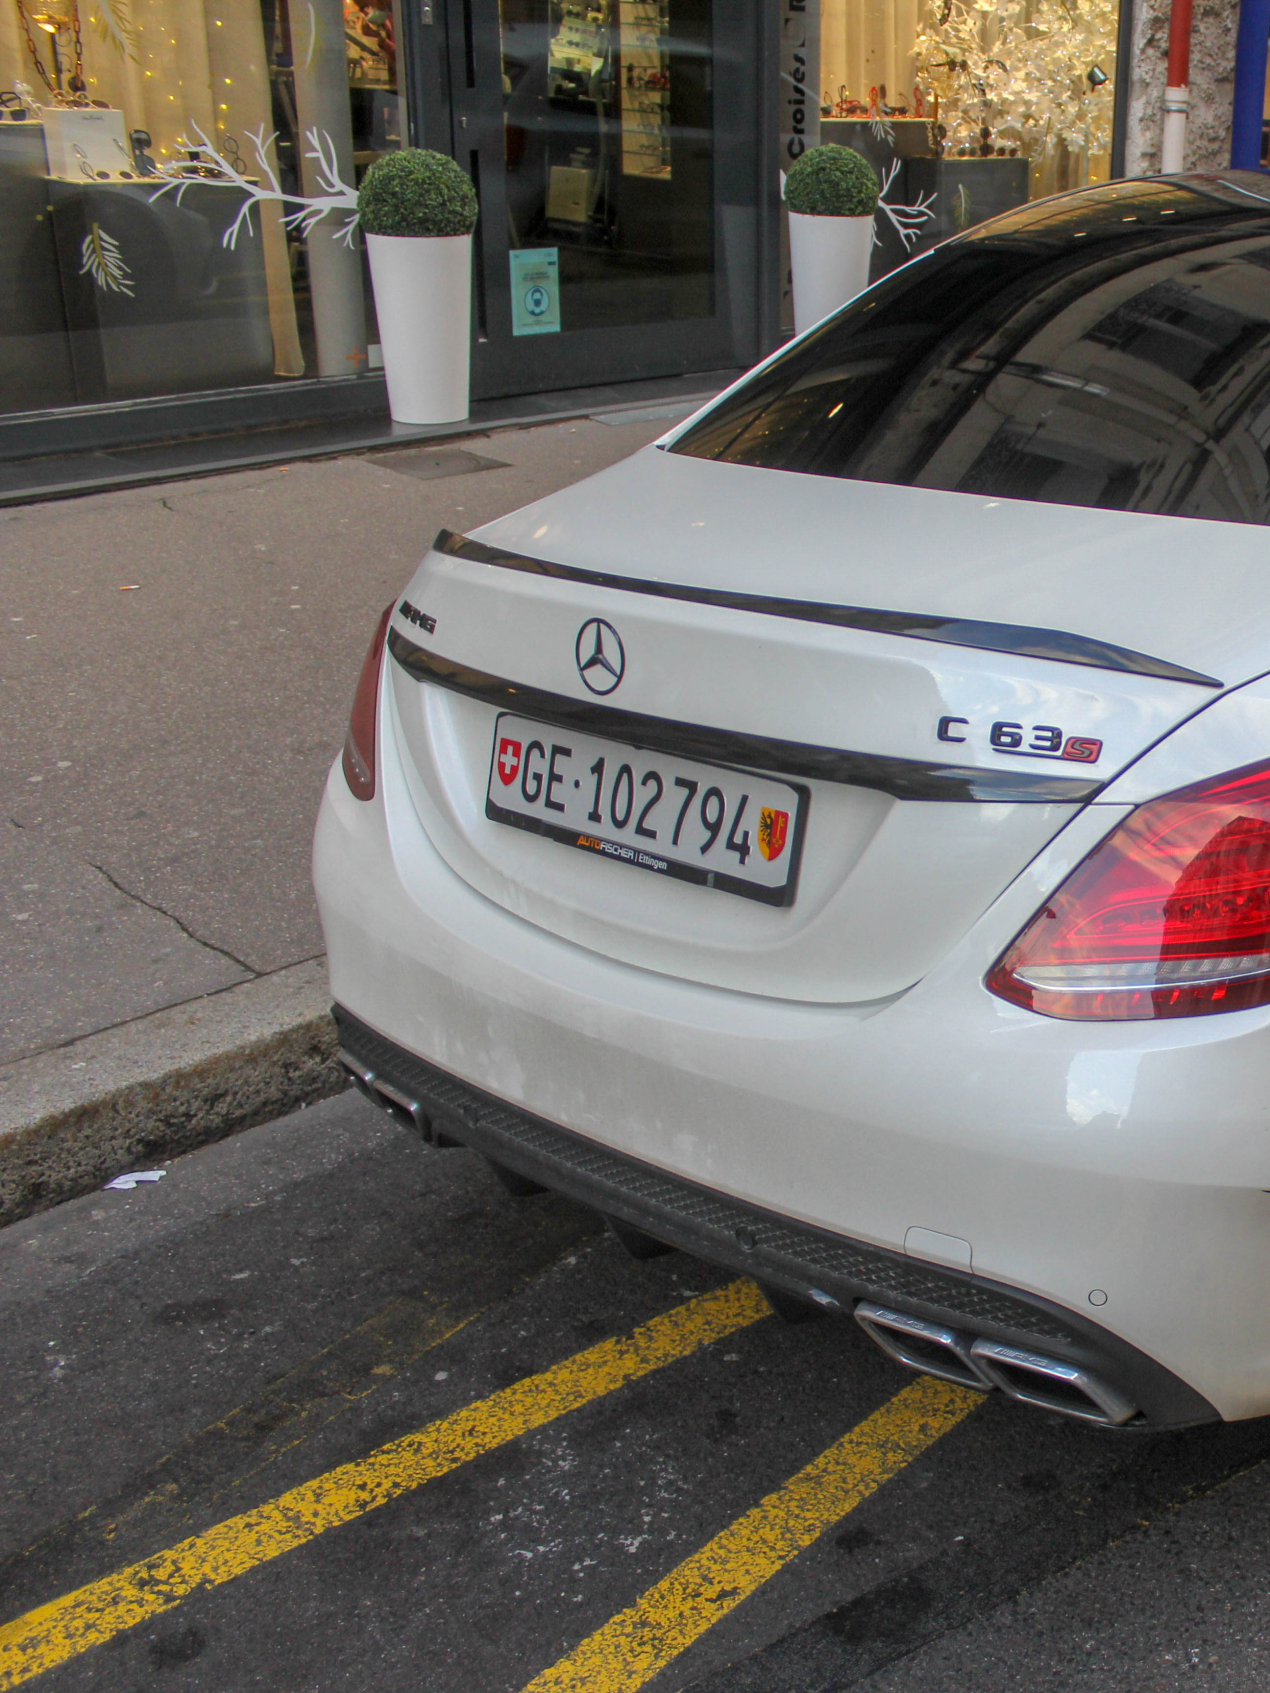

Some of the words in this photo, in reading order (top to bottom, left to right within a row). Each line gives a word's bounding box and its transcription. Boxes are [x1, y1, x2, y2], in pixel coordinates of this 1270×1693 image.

[787, 53, 806, 160] Croisés
[937, 715, 970, 743] C
[576, 835, 634, 860] AUTOFISCHER
[638, 853, 668, 870] Ettingen
